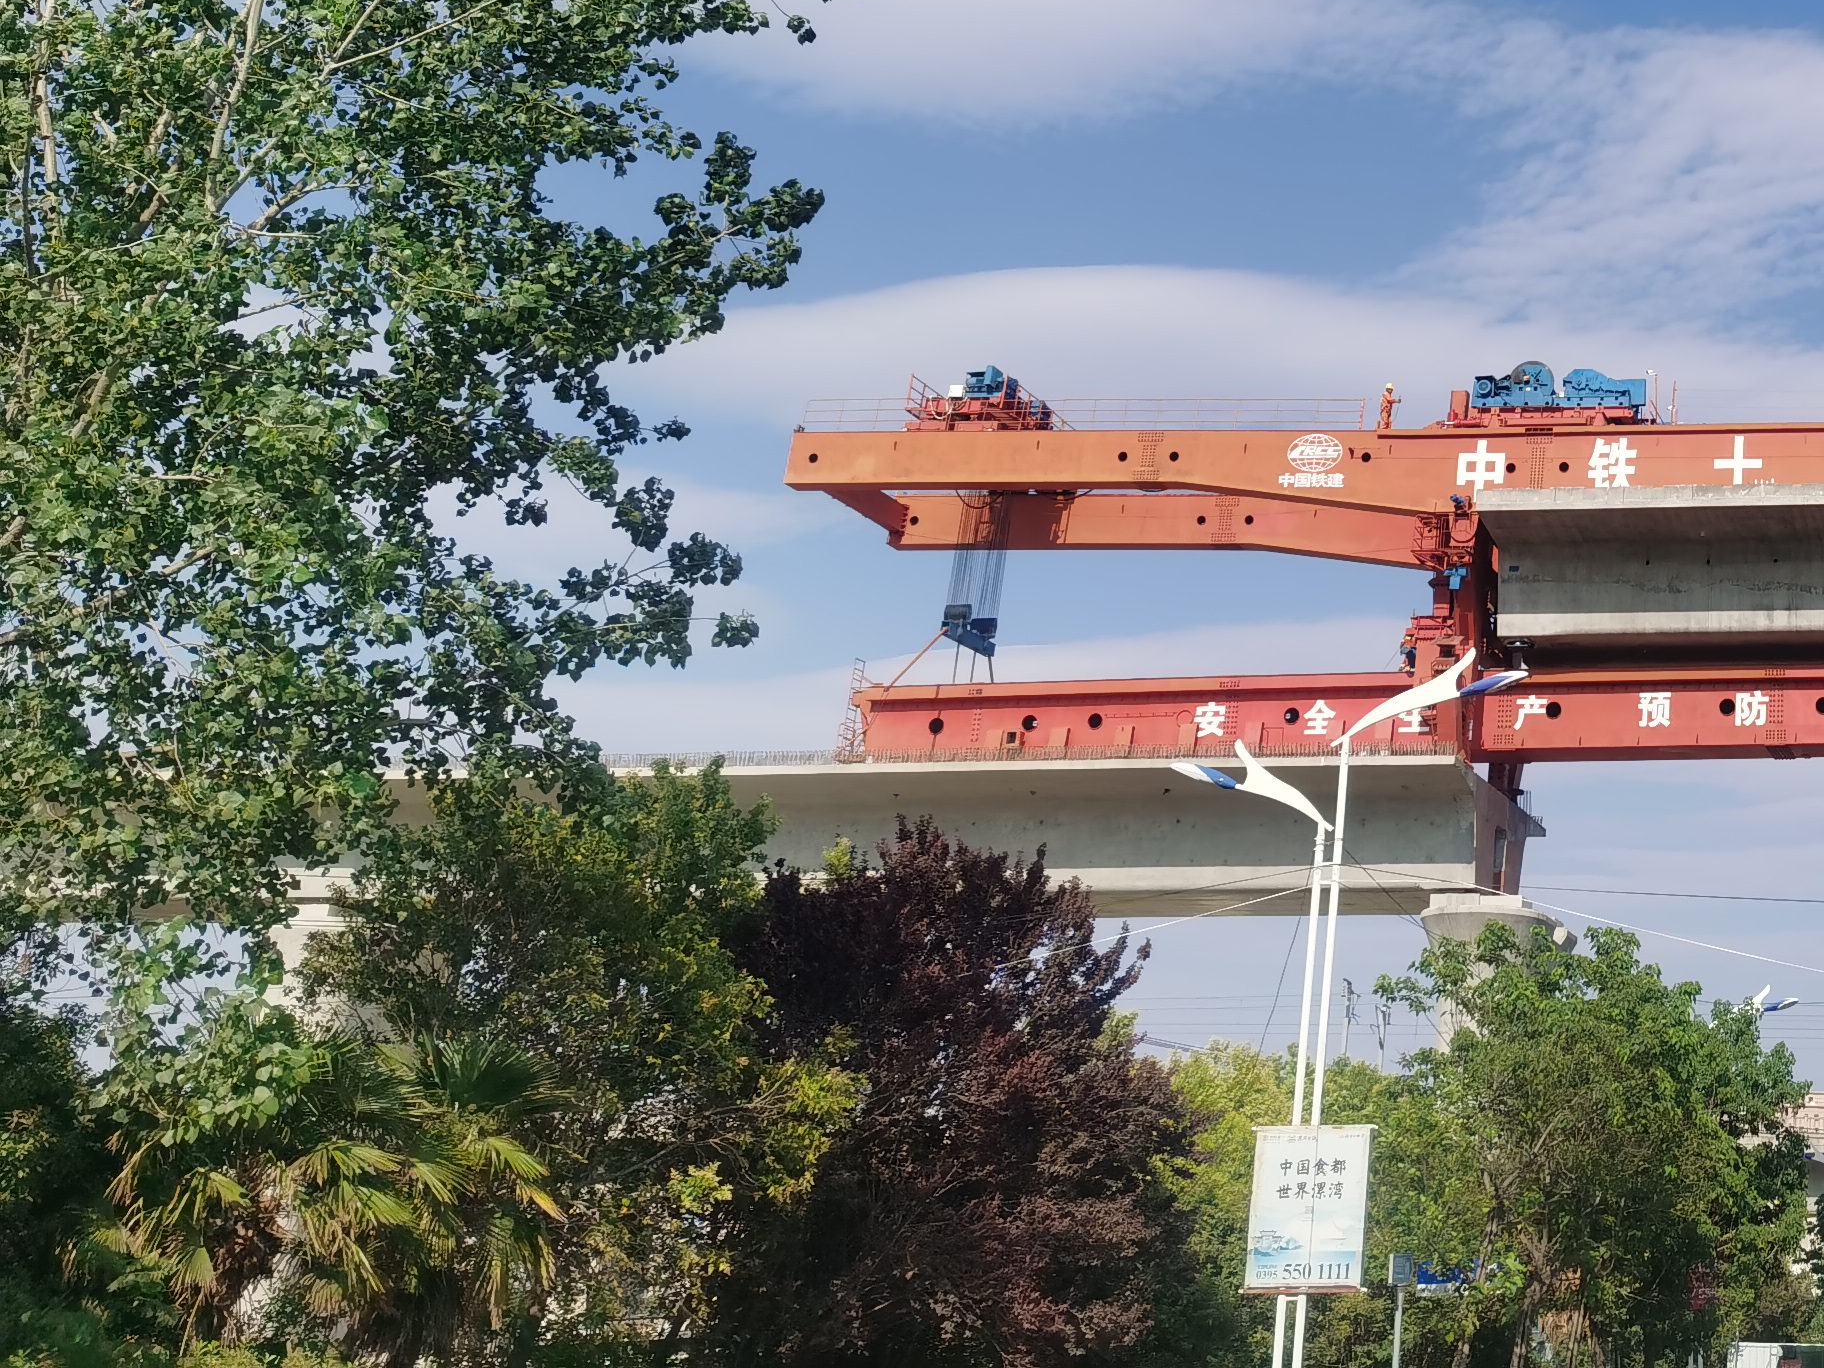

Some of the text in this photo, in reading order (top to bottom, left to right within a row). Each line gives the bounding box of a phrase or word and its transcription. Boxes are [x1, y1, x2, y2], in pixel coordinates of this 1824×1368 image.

[1278, 473, 1345, 488] 中国铁建
[1280, 1158, 1347, 1177] 中国食都
[1276, 1181, 1344, 1200] 世界漯湾
[1256, 1263, 1350, 1280] 0395 550 1111
